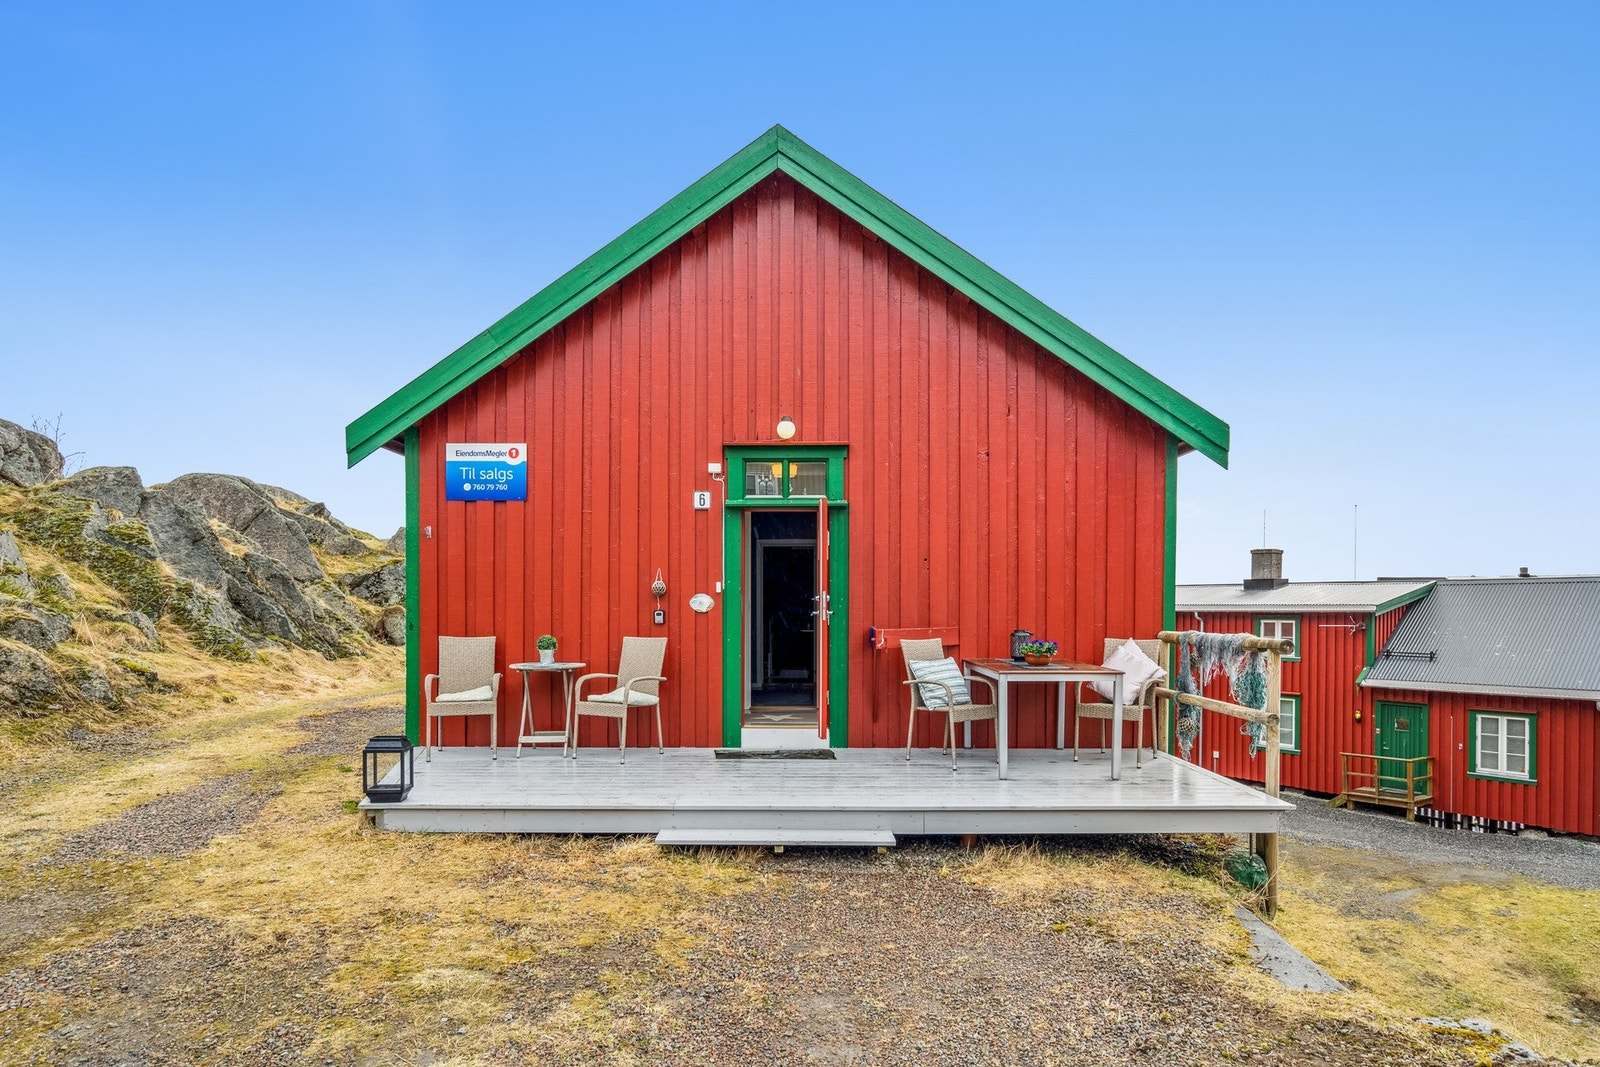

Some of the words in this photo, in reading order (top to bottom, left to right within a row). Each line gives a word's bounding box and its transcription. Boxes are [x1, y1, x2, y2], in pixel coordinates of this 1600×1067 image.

[455, 449, 508, 458] EiendomsMegler
[459, 467, 476, 479] Til
[479, 467, 513, 483] salgs
[472, 483, 485, 491] 760
[486, 483, 494, 491] 79
[495, 483, 508, 491] 760
[699, 493, 706, 507] 6
